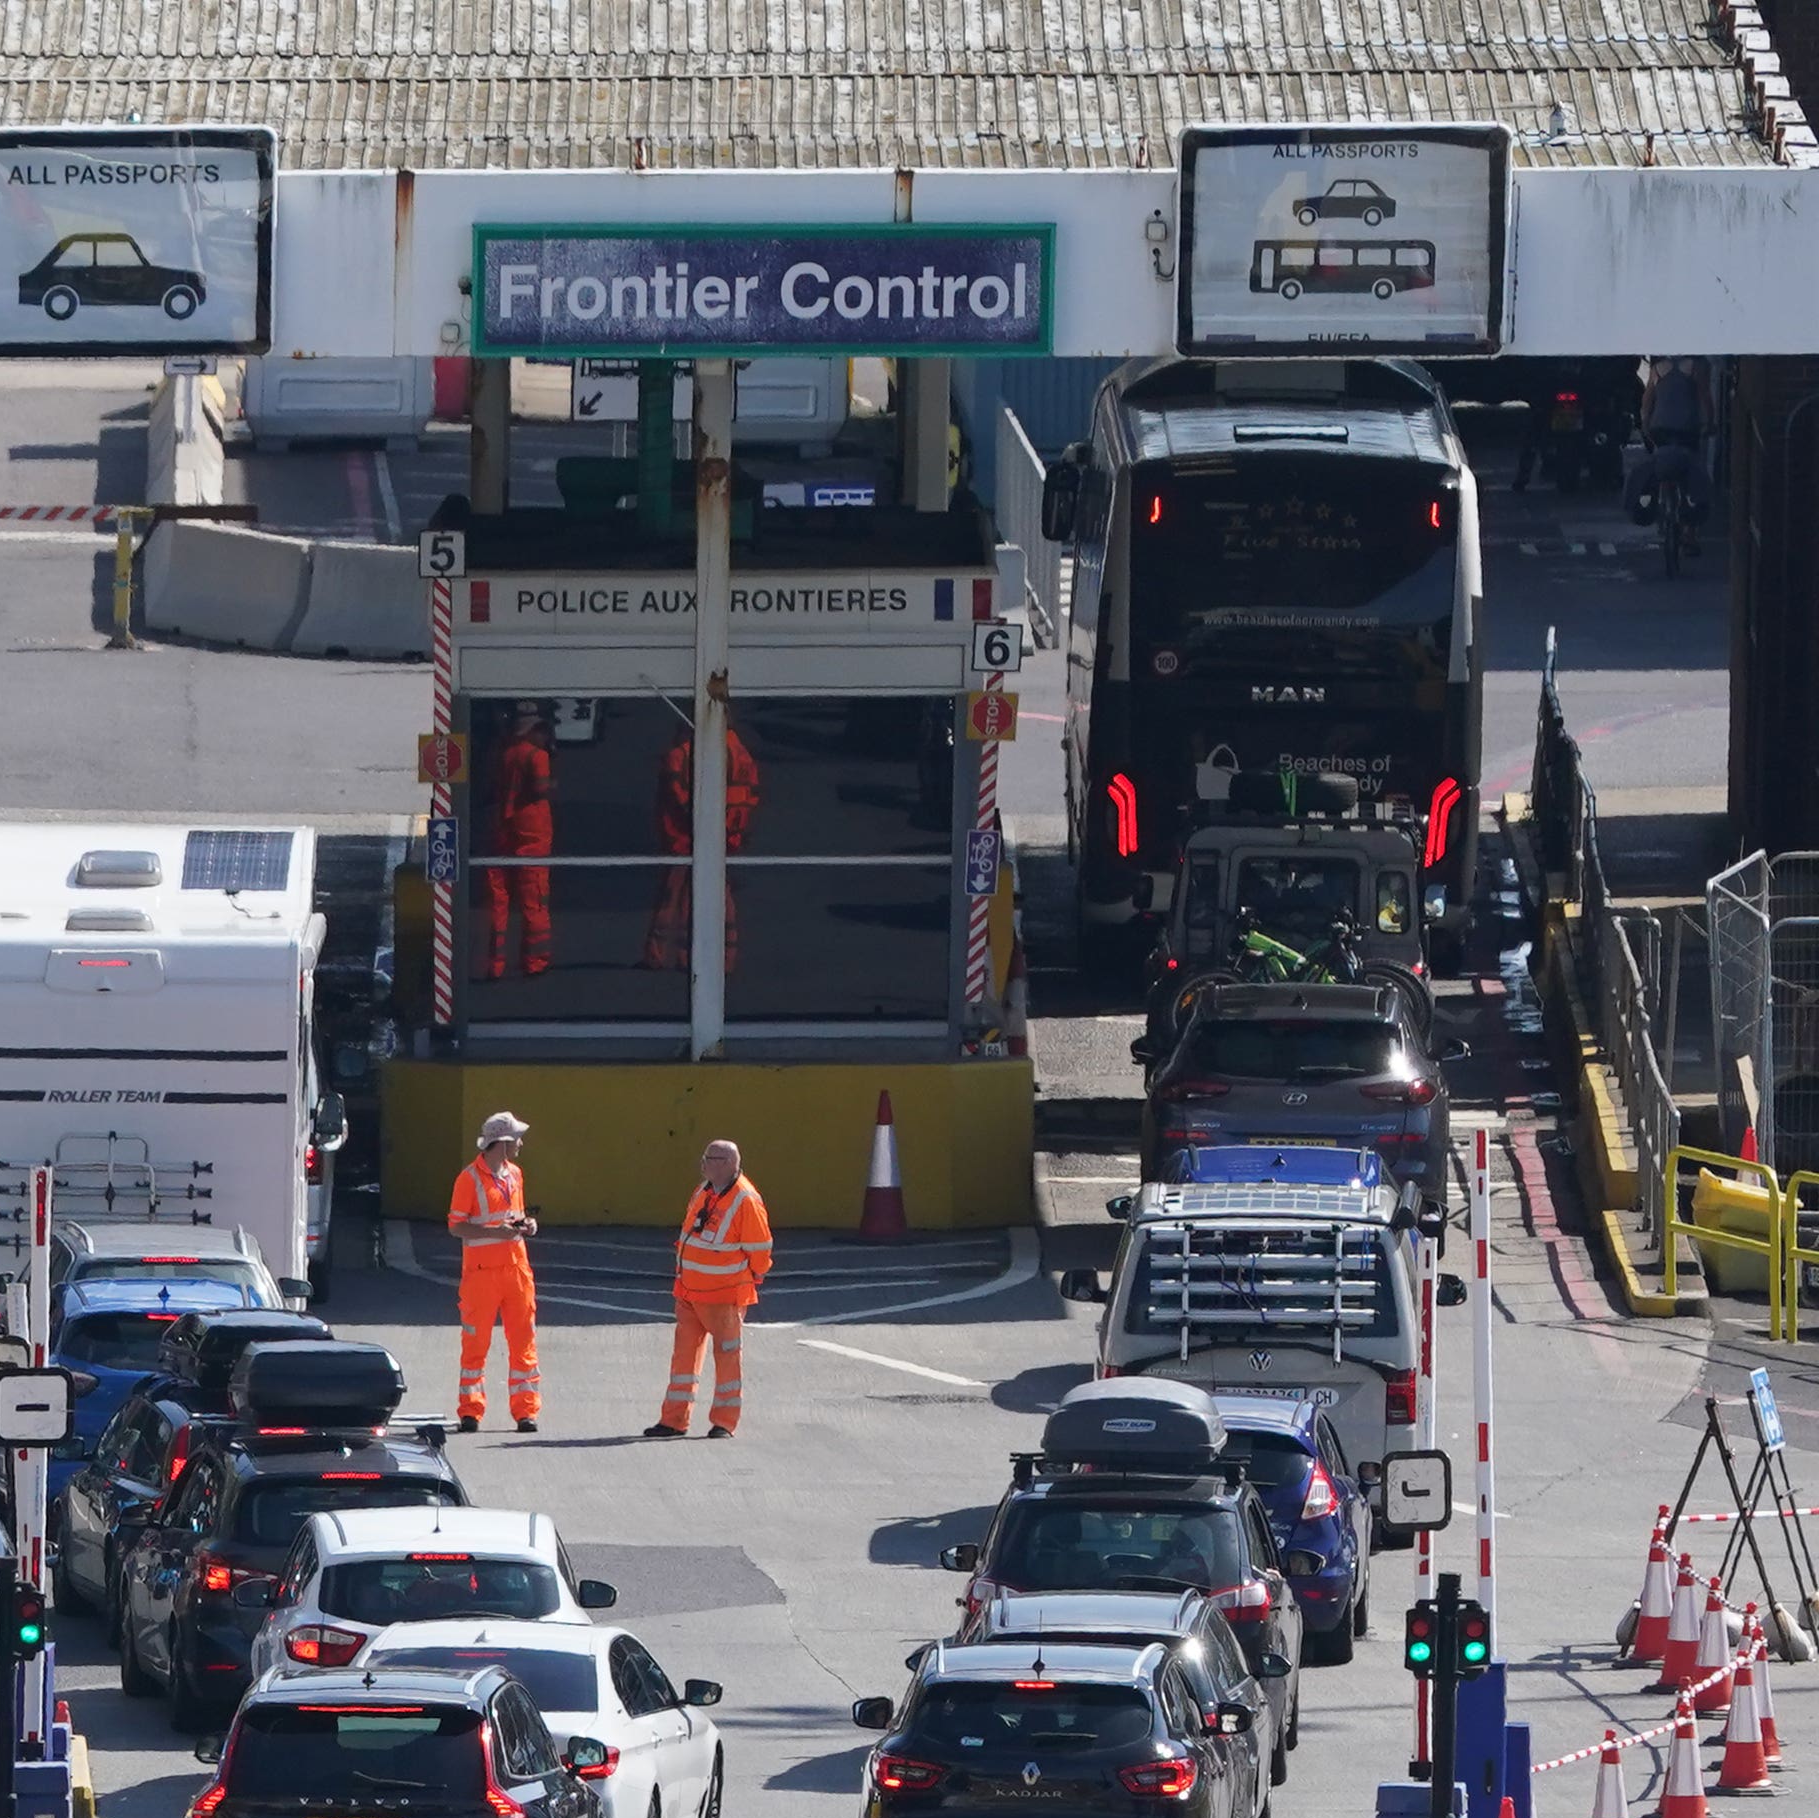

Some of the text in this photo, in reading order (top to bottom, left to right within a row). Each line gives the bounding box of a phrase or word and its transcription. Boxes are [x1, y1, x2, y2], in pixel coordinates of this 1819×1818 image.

[1273, 143, 1421, 161] ALL PASSPORTS
[8, 163, 221, 185] ALL PASSPORTS
[499, 261, 1028, 321] Frontier Control
[430, 535, 456, 573] 5
[517, 590, 910, 614] POLICE AUX RONTIERES
[983, 629, 1011, 667] 6
[1251, 685, 1326, 703] MAN
[985, 694, 1000, 736] STOP
[434, 736, 448, 778] STOP
[1278, 752, 1392, 773] Beaches of
[48, 1089, 163, 1105] ROLLER TEAM
[1315, 1389, 1334, 1406] CH
[298, 1796, 412, 1807] VOLVO
[995, 1788, 1063, 1800] KADJAR
